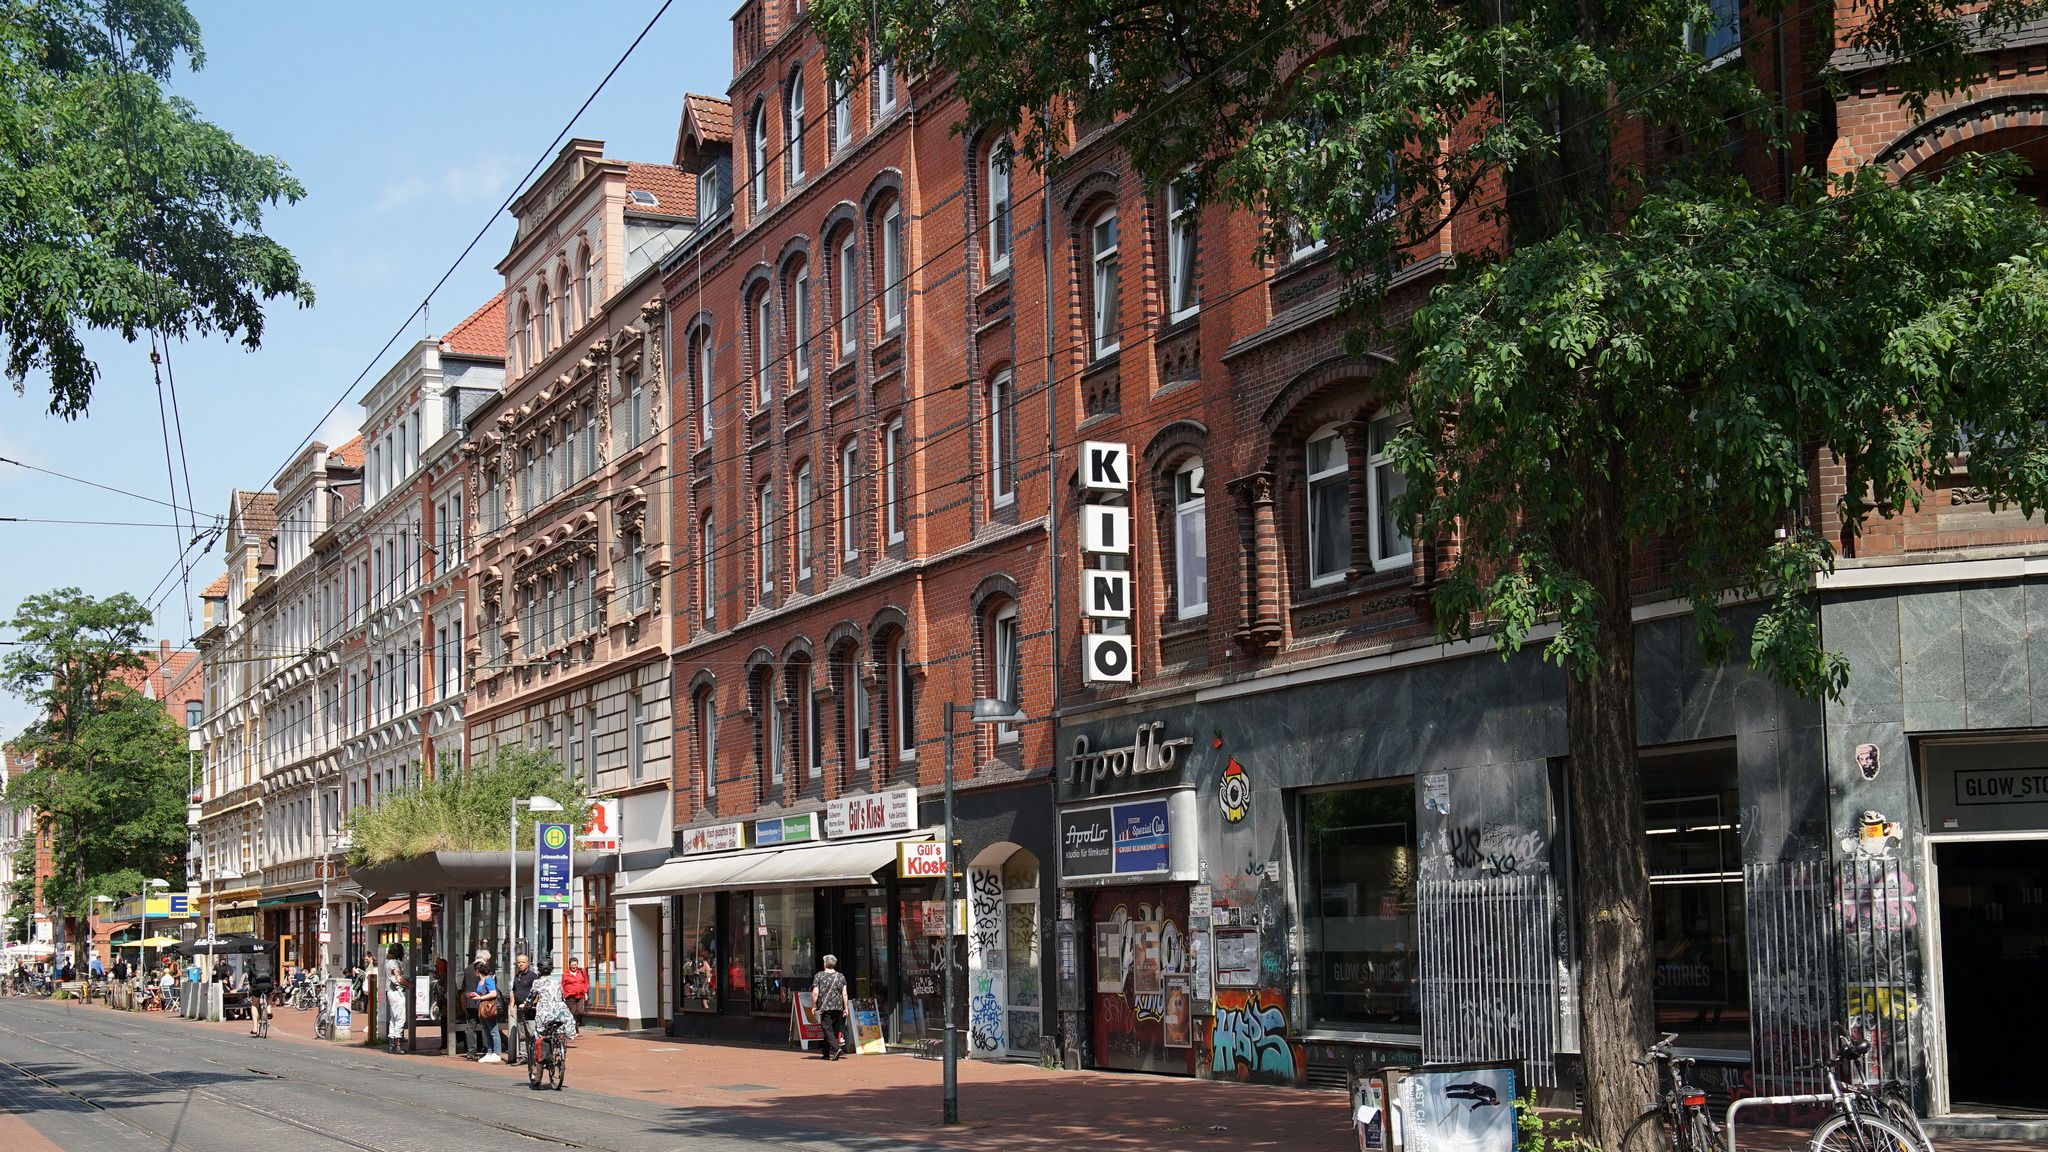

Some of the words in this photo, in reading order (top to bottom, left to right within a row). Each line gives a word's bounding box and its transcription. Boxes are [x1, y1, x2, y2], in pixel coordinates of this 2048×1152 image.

[1091, 449, 1128, 677] KINO
[1063, 720, 1194, 793] Apollo
[866, 797, 885, 830] Kiosk
[1065, 823, 1108, 848] Apollo
[1132, 823, 1152, 837] Spezial
[1152, 816, 1165, 836] Club
[1065, 850, 1080, 859] studio
[1088, 847, 1110, 857] filmkunst
[908, 857, 947, 875] Kiosk
[170, 896, 188, 913] E
